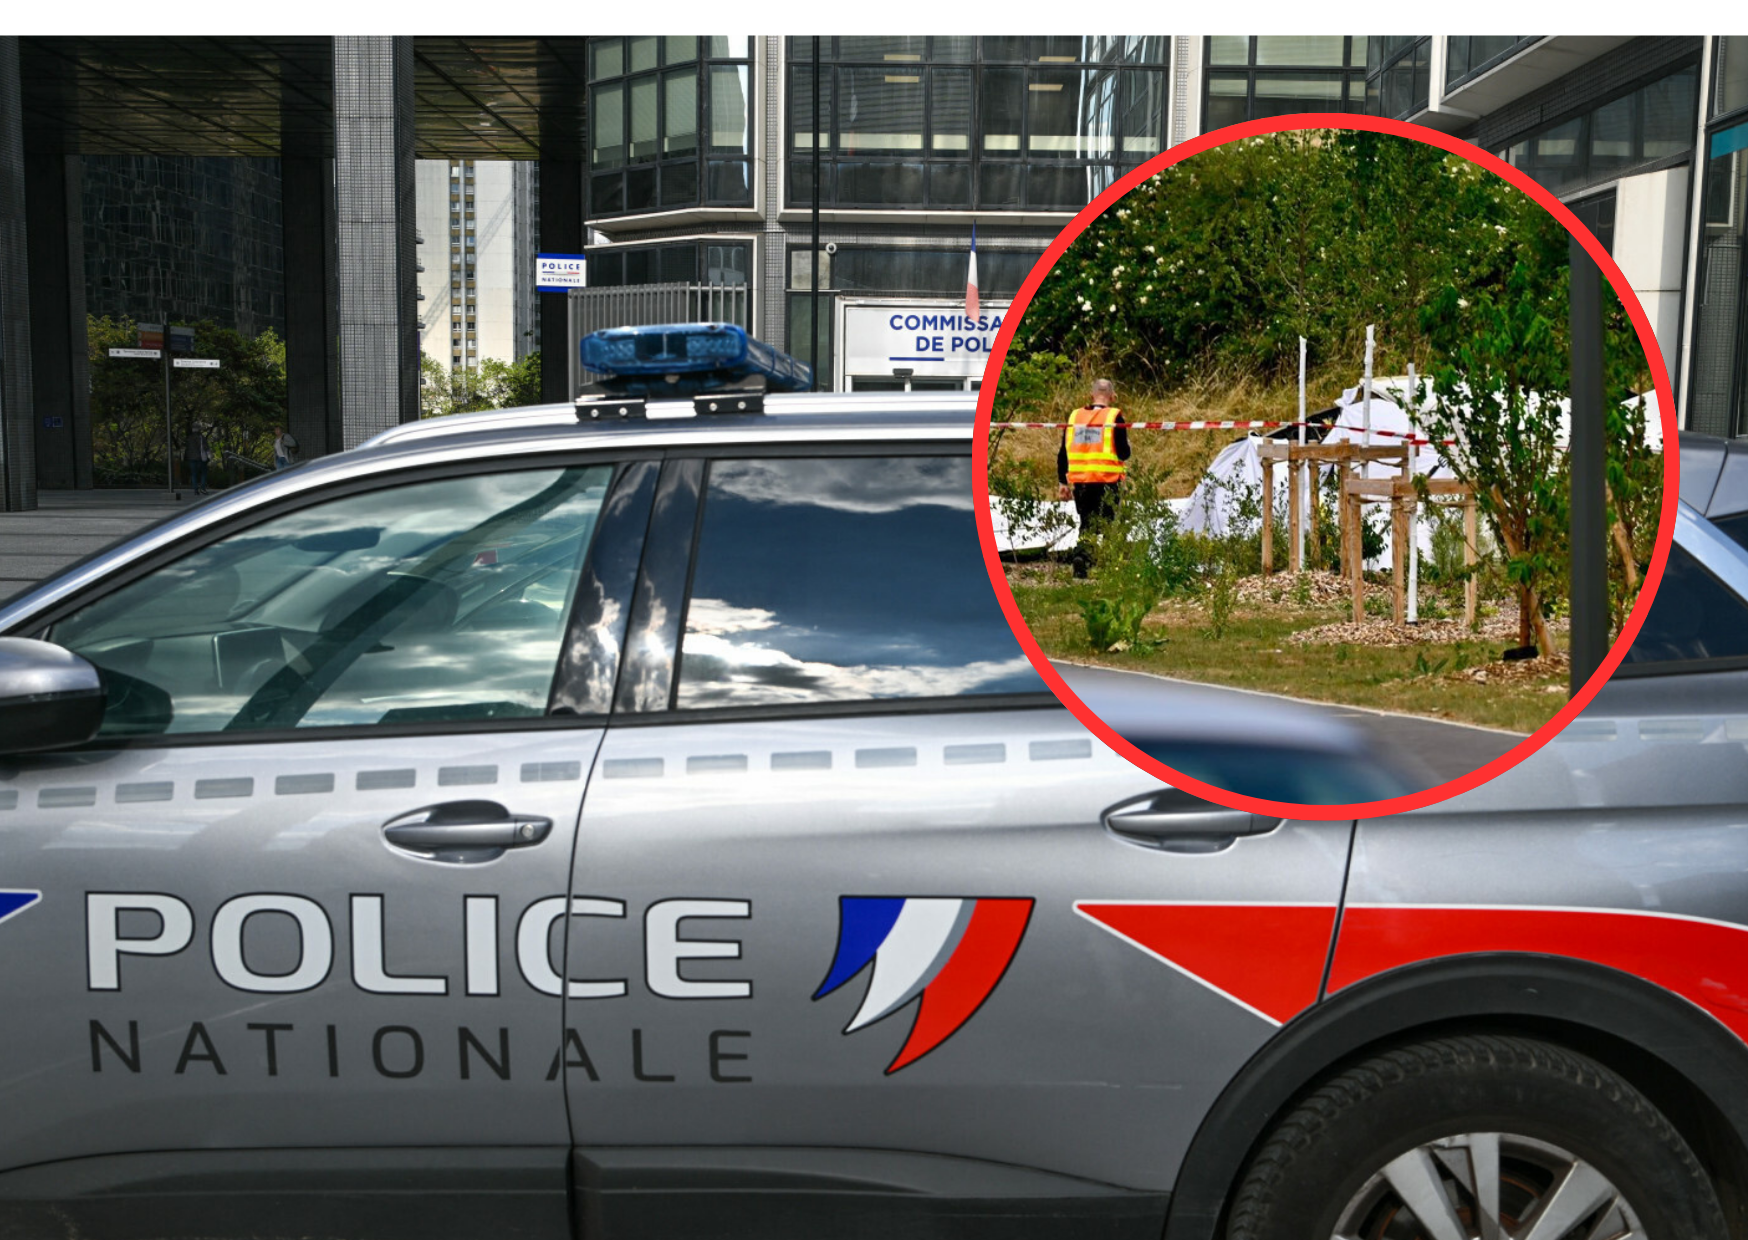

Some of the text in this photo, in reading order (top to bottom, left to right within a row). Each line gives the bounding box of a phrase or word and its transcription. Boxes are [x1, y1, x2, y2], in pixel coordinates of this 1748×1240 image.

[542, 262, 580, 270] POLICE
[915, 336, 992, 352] DE POL
[84, 891, 754, 999] POLICE
[88, 1019, 753, 1083] NATIONALE
